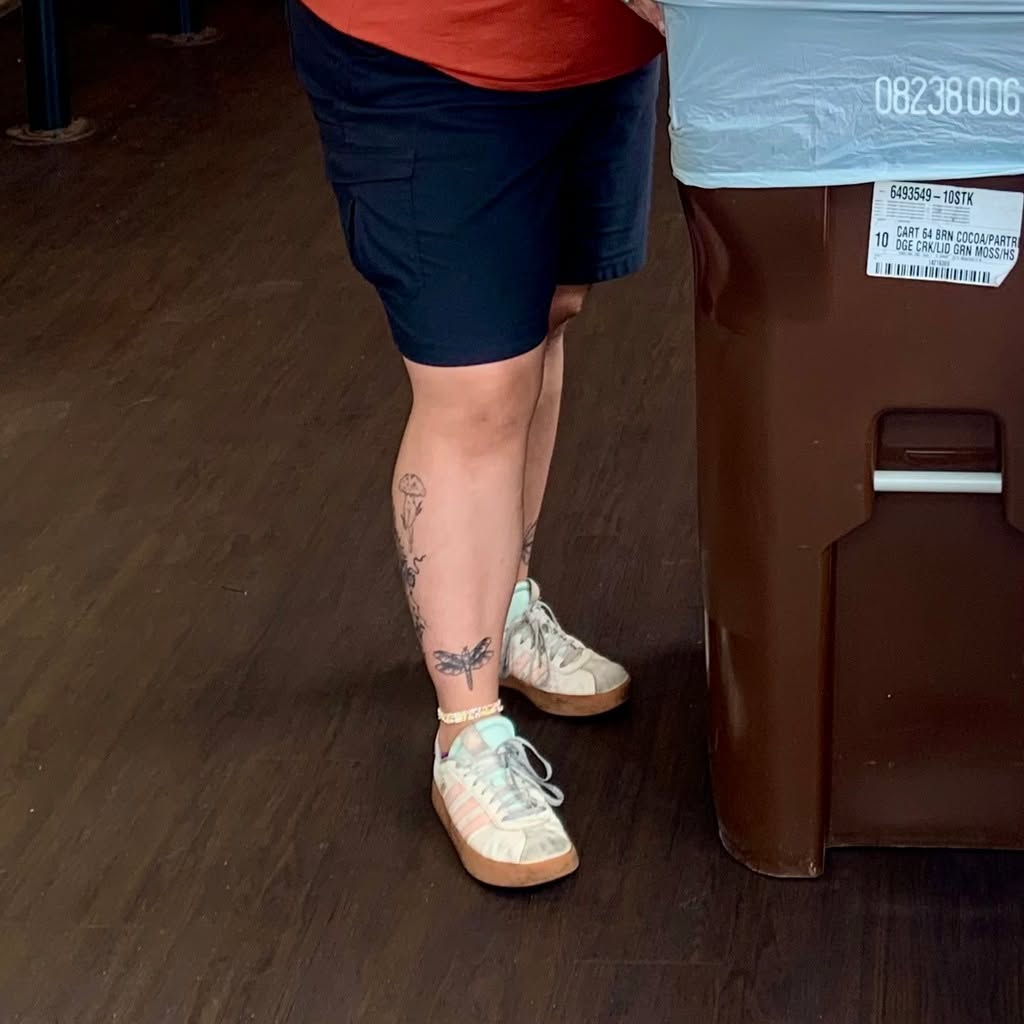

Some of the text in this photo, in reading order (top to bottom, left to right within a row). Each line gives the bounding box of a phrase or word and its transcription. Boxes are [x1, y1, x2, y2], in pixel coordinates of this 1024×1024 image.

[875, 231, 889, 248] 10
[896, 226, 920, 239] CART
[922, 227, 933, 240] 64
[936, 229, 953, 242] BRN
[896, 239, 913, 252] DGE
[916, 241, 950, 255] CRK/LID
[953, 244, 972, 257] GRN
[975, 246, 1015, 261] MOSS/HS
